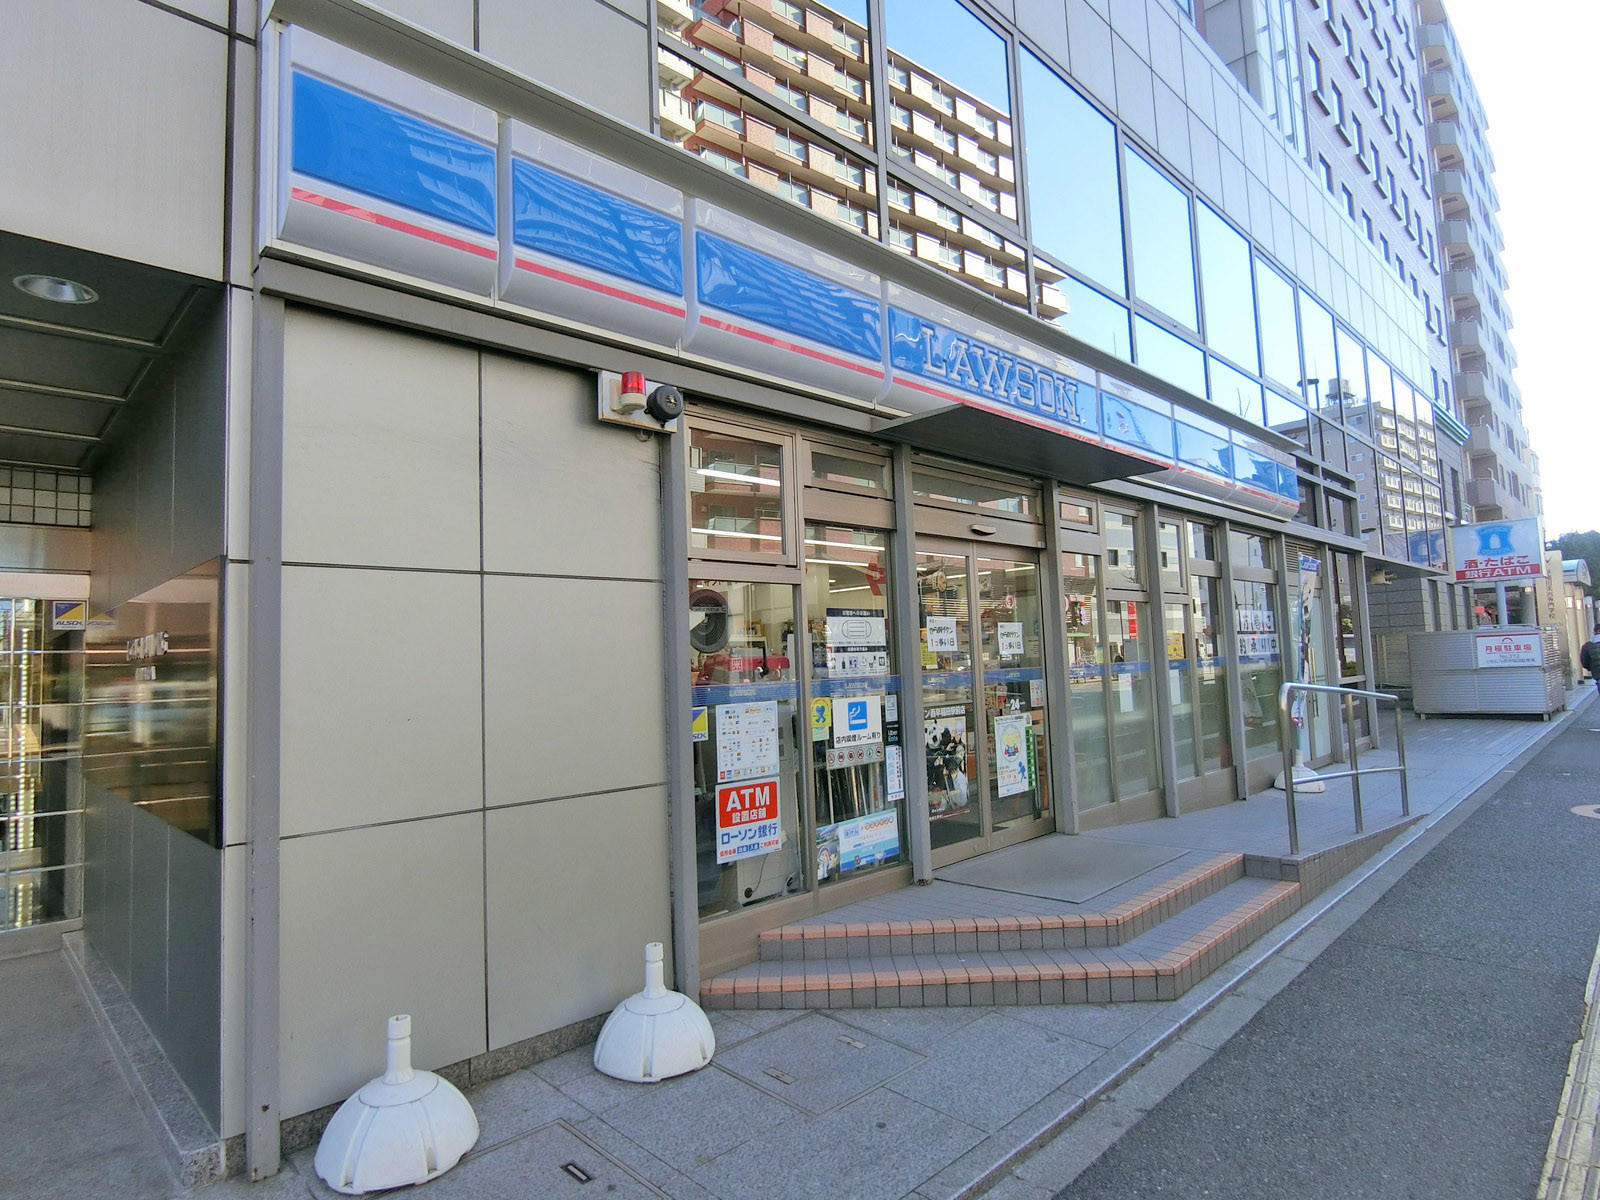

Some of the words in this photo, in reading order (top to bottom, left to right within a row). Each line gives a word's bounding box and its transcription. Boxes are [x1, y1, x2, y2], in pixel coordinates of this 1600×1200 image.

[921, 323, 1080, 422] LAWSON
[1464, 566, 1532, 579] 銀行ATM
[1485, 644, 1532, 652] 月極駐車場
[835, 731, 881, 744] 店内喫煙ルーム有り
[726, 785, 770, 812] ATM
[732, 807, 767, 824] 設置店舗
[721, 822, 778, 845] ローソン銀行
